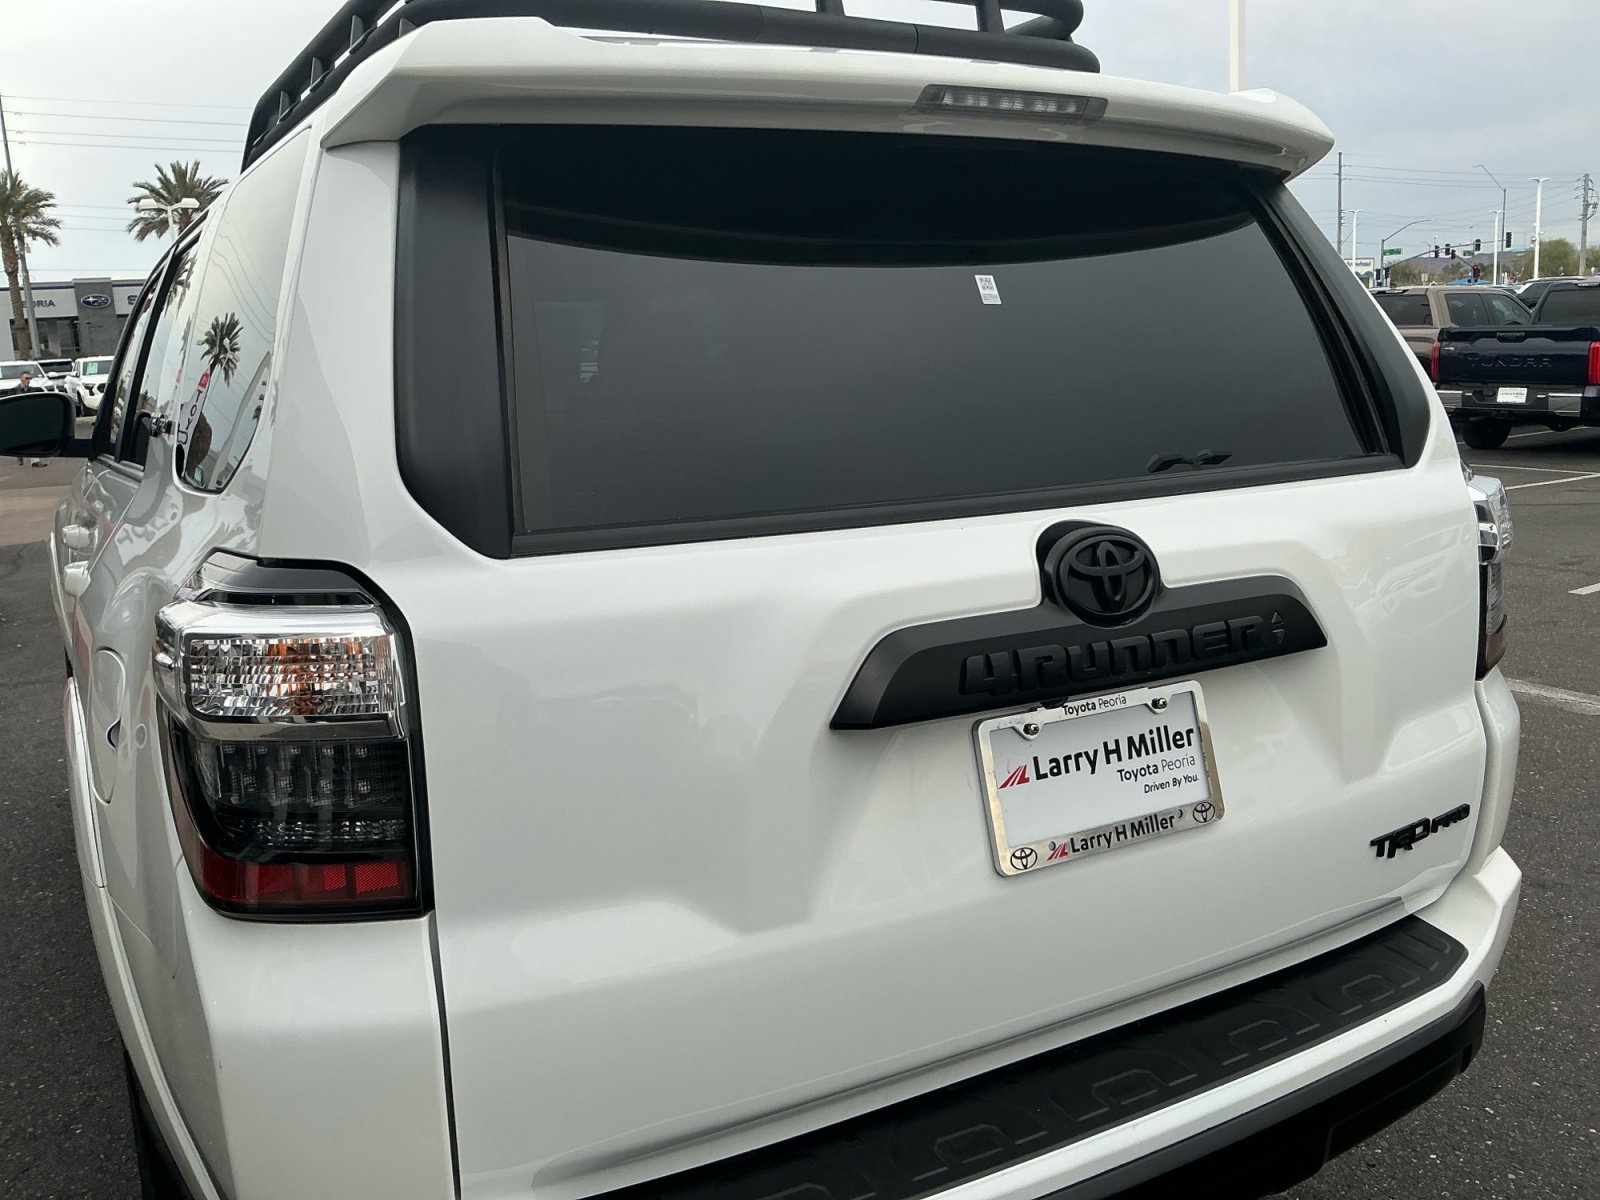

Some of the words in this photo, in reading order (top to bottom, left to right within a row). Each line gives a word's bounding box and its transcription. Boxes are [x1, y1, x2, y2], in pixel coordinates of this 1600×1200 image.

[1062, 701, 1097, 716] Toyota
[1098, 694, 1127, 709] Peoria
[1033, 748, 1099, 781] Larry
[1103, 738, 1123, 765] H
[1127, 725, 1195, 760] Miller
[1116, 763, 1159, 782] Toyota
[1161, 753, 1196, 772] Peoria
[1144, 781, 1171, 794] Driven
[1172, 777, 1183, 788] By
[1070, 831, 1113, 853] Larry
[1114, 824, 1128, 842] H
[1130, 814, 1175, 838] Miller
[1369, 817, 1431, 859] TRD
[1431, 803, 1471, 834] PRO
